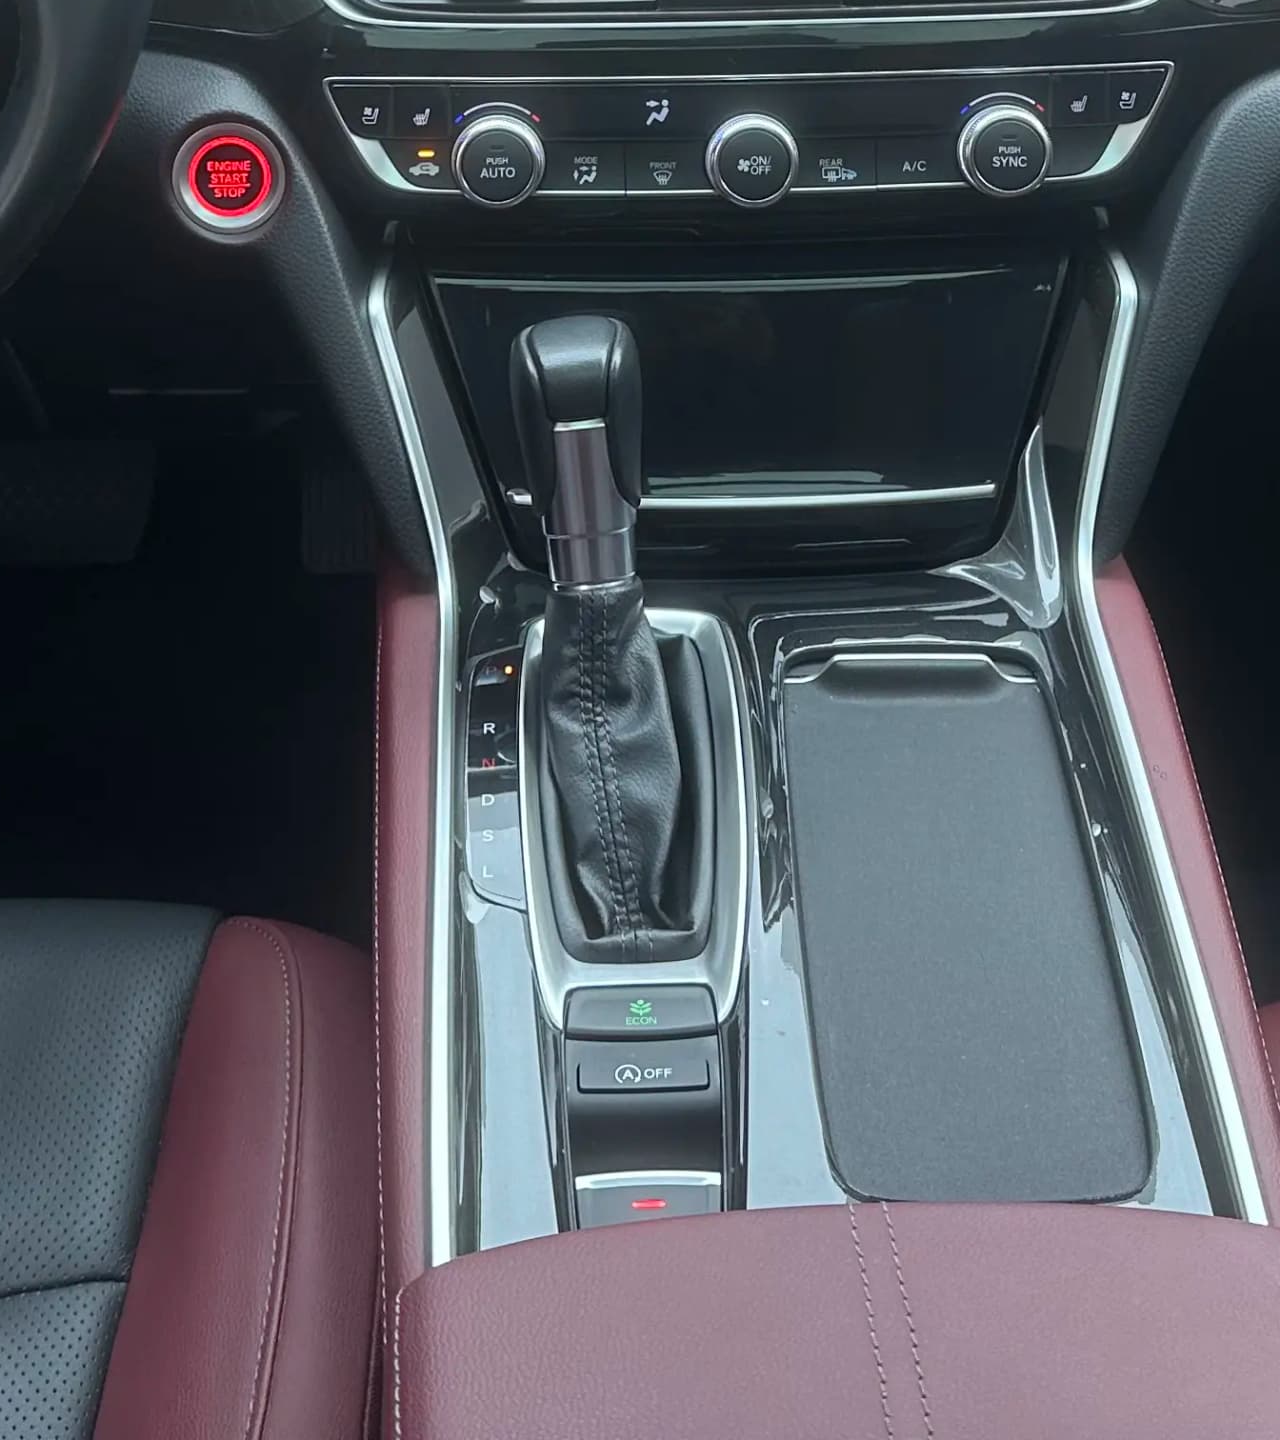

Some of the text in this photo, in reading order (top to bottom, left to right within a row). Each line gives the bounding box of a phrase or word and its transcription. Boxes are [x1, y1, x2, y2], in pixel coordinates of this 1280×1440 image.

[998, 145, 1021, 154] PUSH
[206, 160, 252, 172] ENGINE
[486, 157, 509, 165] PUSH
[574, 156, 598, 165] MODE
[649, 161, 677, 170] FRONT
[819, 158, 843, 167] REAR
[902, 160, 927, 172] A/C
[992, 156, 1028, 168] SYNC
[480, 167, 516, 179] AUTO
[750, 165, 772, 176] OFF
[210, 173, 249, 184] START
[214, 187, 246, 198] STOP
[483, 722, 496, 735] R
[482, 757, 496, 769] N
[481, 793, 495, 807] D
[482, 829, 495, 842] S
[483, 865, 494, 878] L
[625, 1016, 657, 1025] ECON
[644, 1067, 673, 1079] OFF
